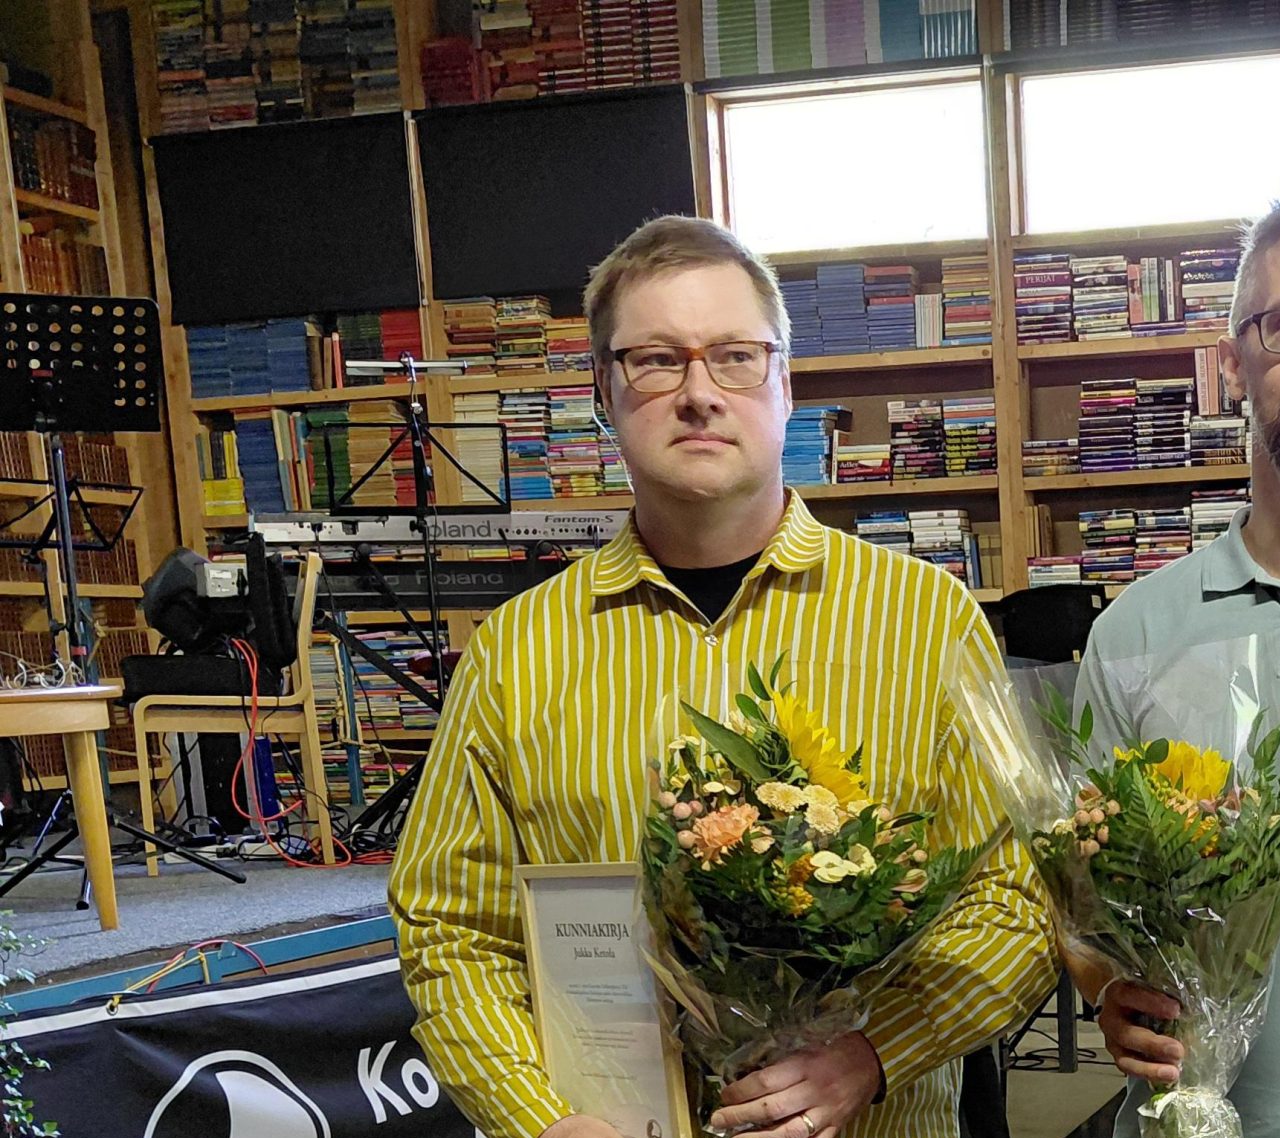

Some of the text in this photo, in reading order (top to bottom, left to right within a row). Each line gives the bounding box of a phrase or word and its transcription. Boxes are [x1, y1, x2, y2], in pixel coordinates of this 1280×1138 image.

[544, 514, 614, 524] Fantom-S
[555, 923, 629, 940] KUNNIAKIRJA
[574, 947, 592, 960] Jukka
[357, 1040, 439, 1124] Ko
